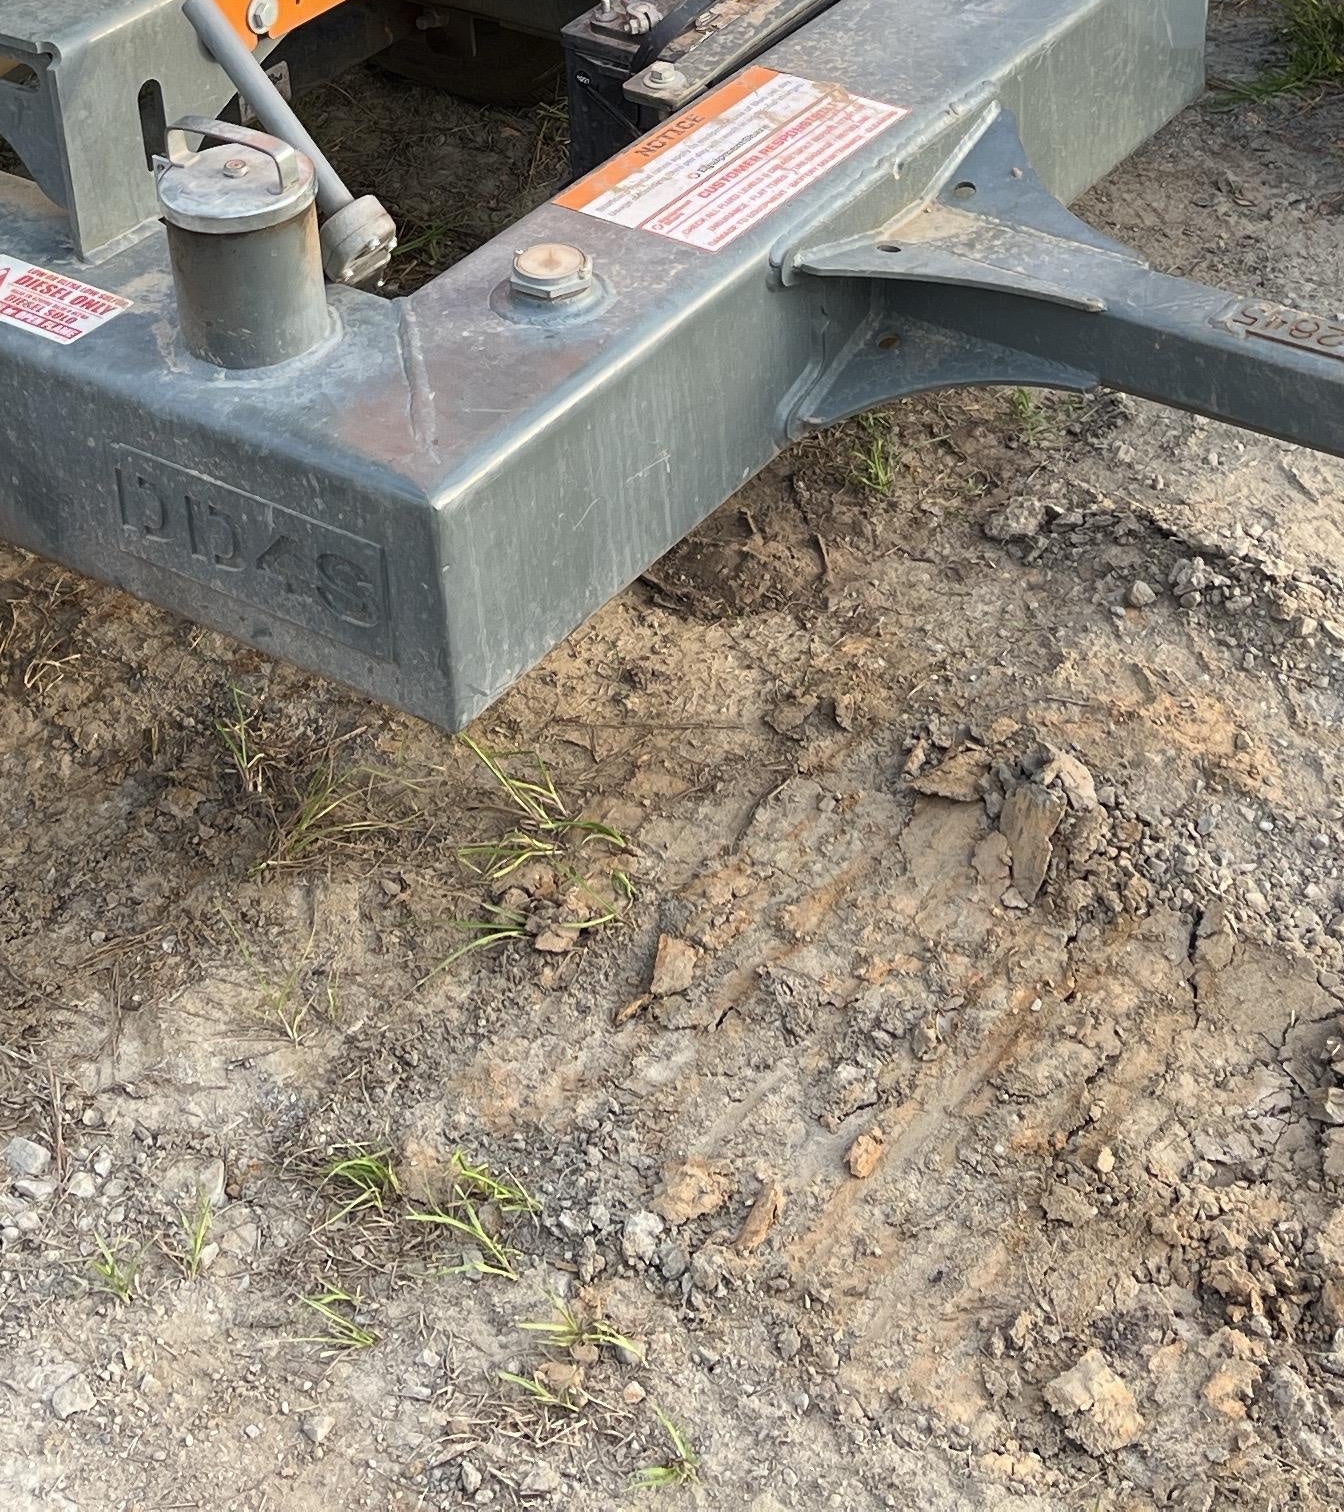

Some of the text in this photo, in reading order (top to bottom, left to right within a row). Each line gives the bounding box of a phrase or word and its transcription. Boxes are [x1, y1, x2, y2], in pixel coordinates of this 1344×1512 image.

[632, 112, 707, 158] NOTICE
[694, 154, 764, 199] CUSTOMER
[4, 292, 46, 313] DIESEL
[43, 308, 79, 325] SOLO
[14, 274, 73, 302] DIESEL
[68, 294, 119, 316] ONLY
